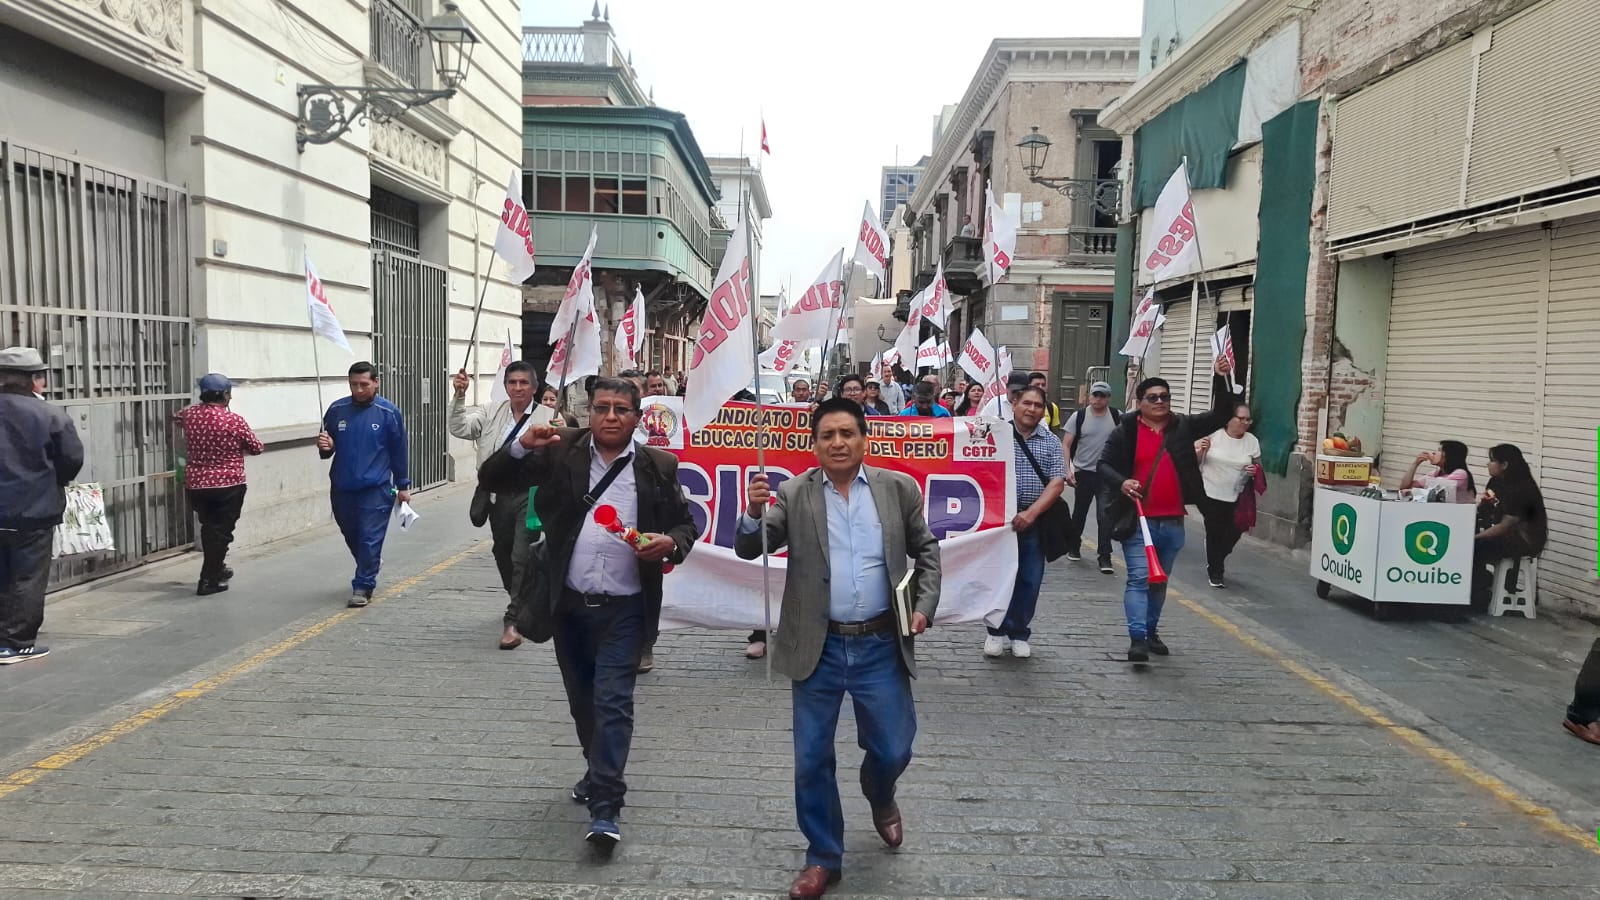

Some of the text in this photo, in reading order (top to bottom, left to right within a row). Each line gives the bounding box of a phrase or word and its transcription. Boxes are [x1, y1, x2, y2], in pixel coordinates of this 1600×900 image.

[711, 409, 793, 428] INDICATO
[910, 424, 932, 437] DE
[871, 441, 900, 456] DEL
[904, 438, 947, 457] PERÚ
[963, 446, 997, 457] CGTP
